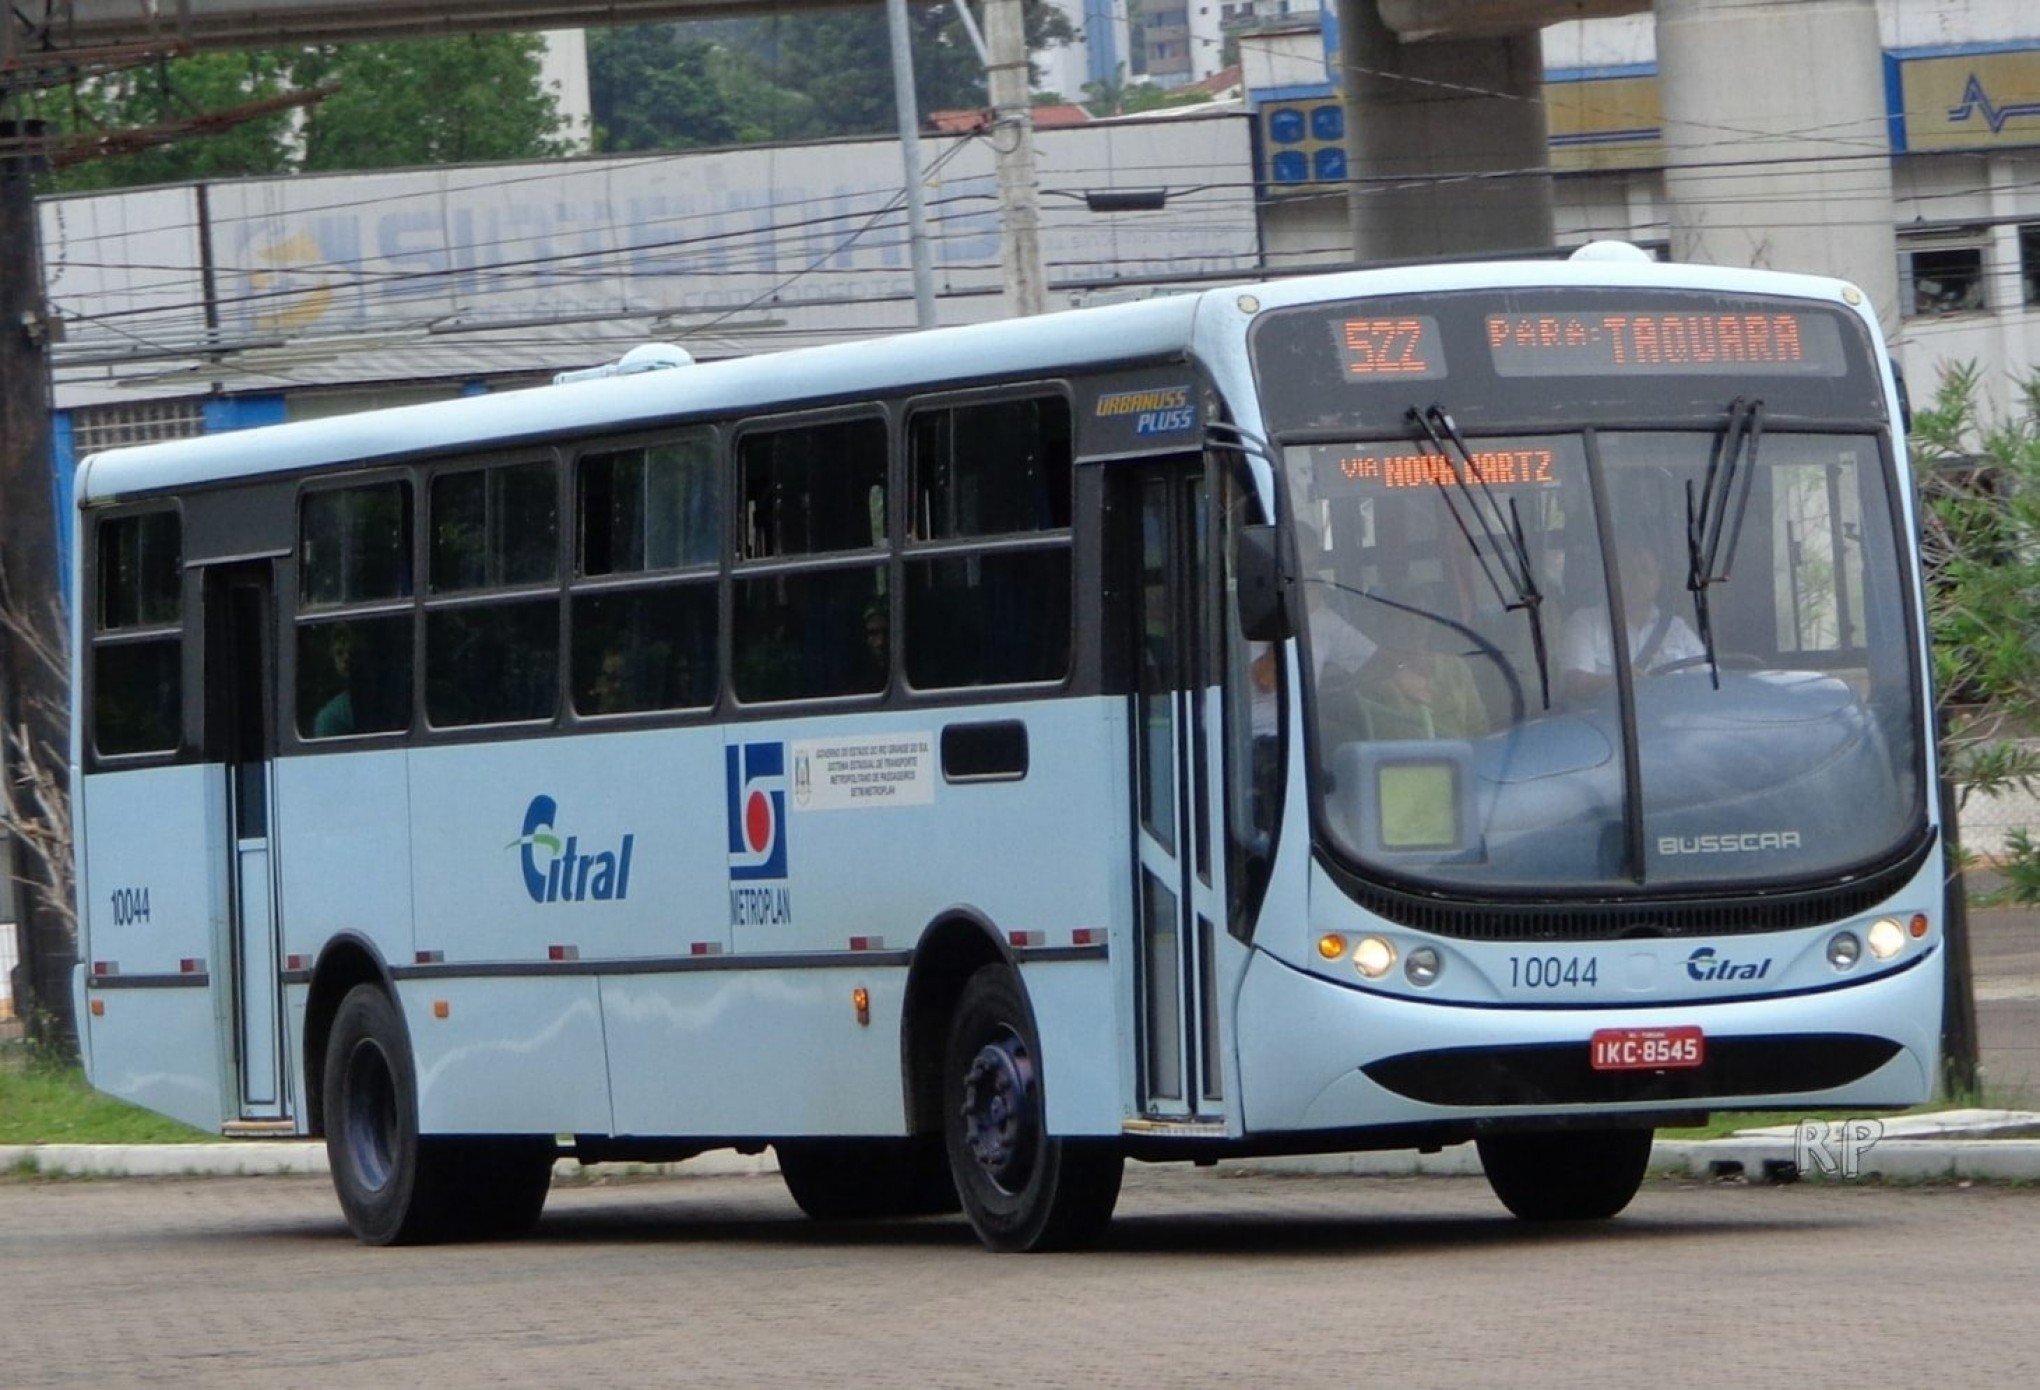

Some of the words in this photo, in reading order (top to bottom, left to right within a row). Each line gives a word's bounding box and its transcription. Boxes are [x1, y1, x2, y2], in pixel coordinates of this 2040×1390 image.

[1345, 316, 1427, 373] 522
[1603, 314, 1802, 364] TAQUARA
[1096, 389, 1187, 417] URBANUSS
[1137, 409, 1194, 434] PLUSS
[1340, 457, 1378, 478] VIA
[520, 793, 634, 902] Citral
[1658, 831, 1800, 855] BUSSCAR
[110, 886, 150, 926] 10044
[730, 887, 790, 925] METROPLAN
[1509, 956, 1598, 988] 10044
[1686, 946, 1772, 981] Citral
